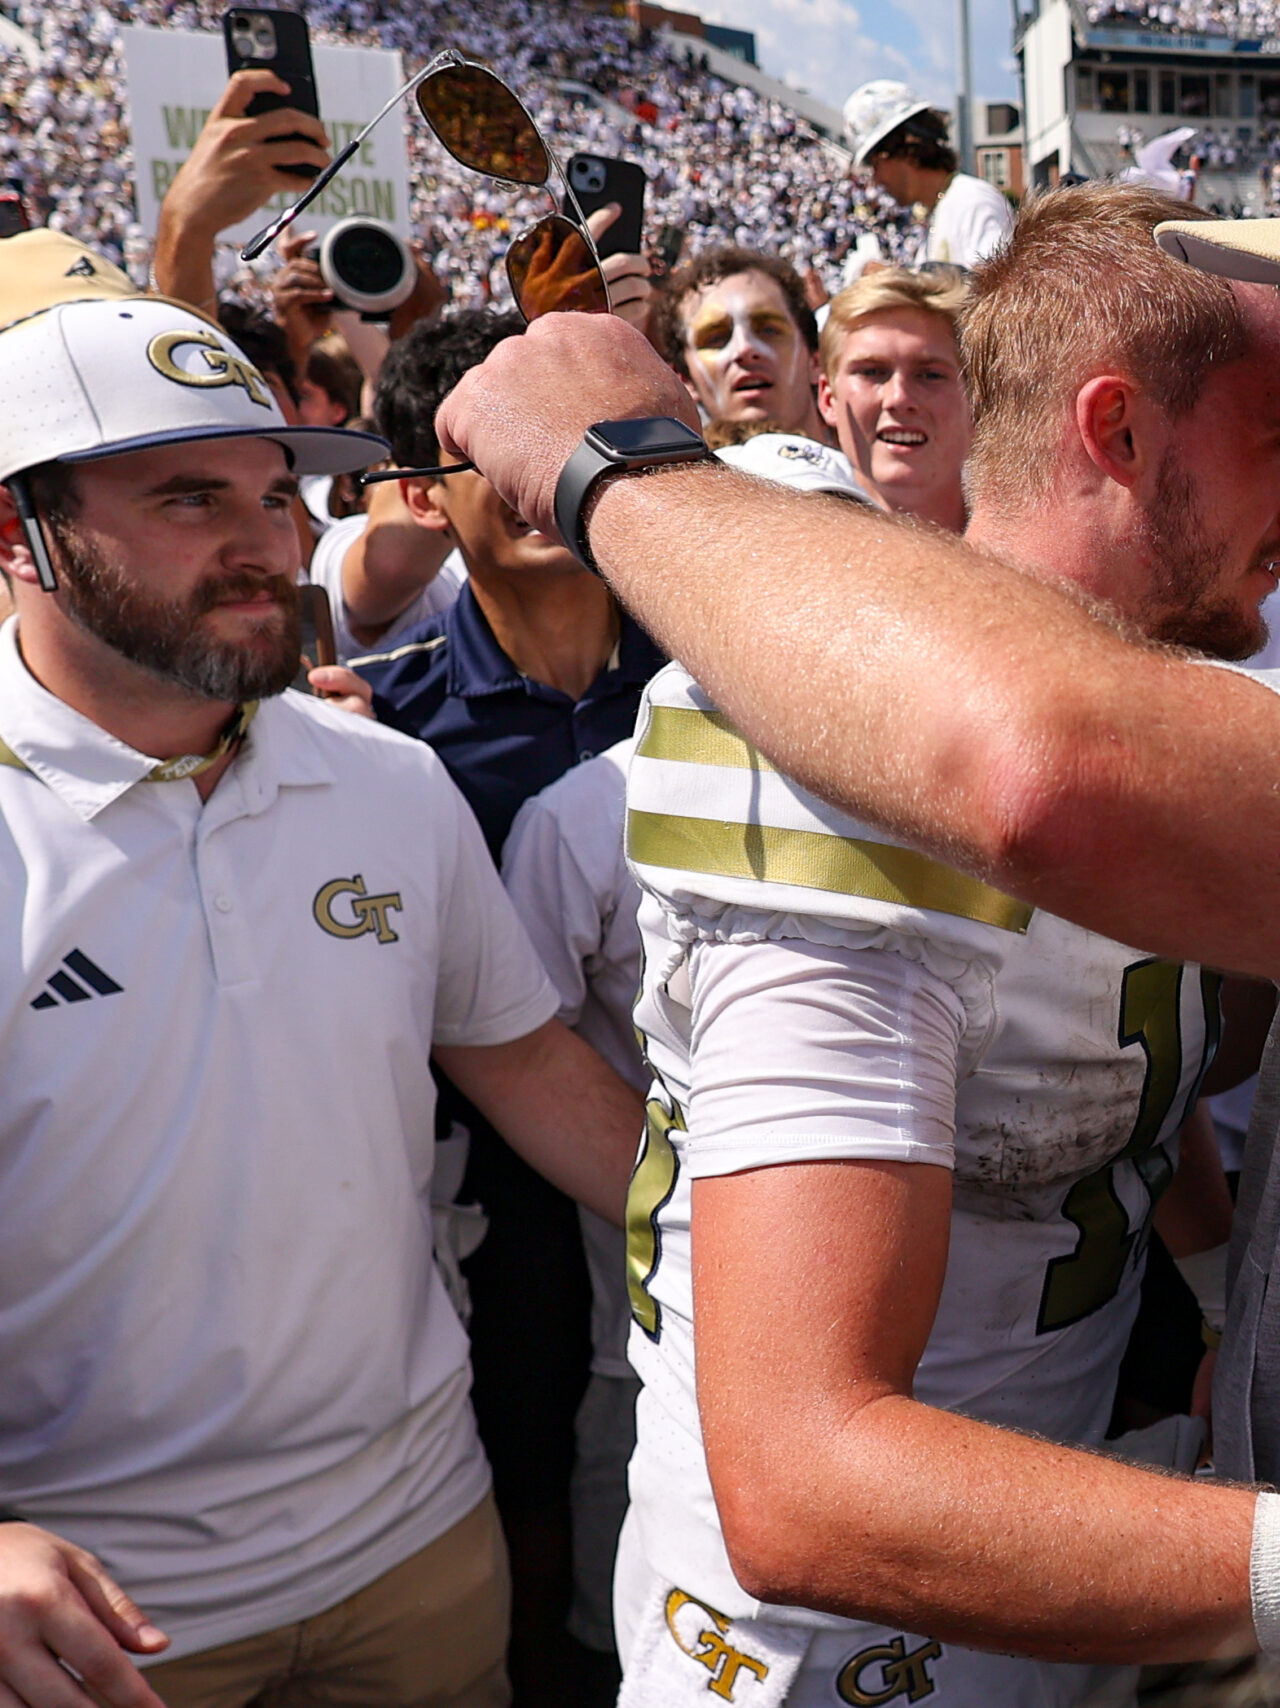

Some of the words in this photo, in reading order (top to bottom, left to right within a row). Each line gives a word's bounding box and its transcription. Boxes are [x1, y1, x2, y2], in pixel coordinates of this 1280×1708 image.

[147, 328, 273, 410] GT
[312, 873, 403, 944] GT
[665, 1586, 769, 1703] GT
[836, 1635, 943, 1707] GT
